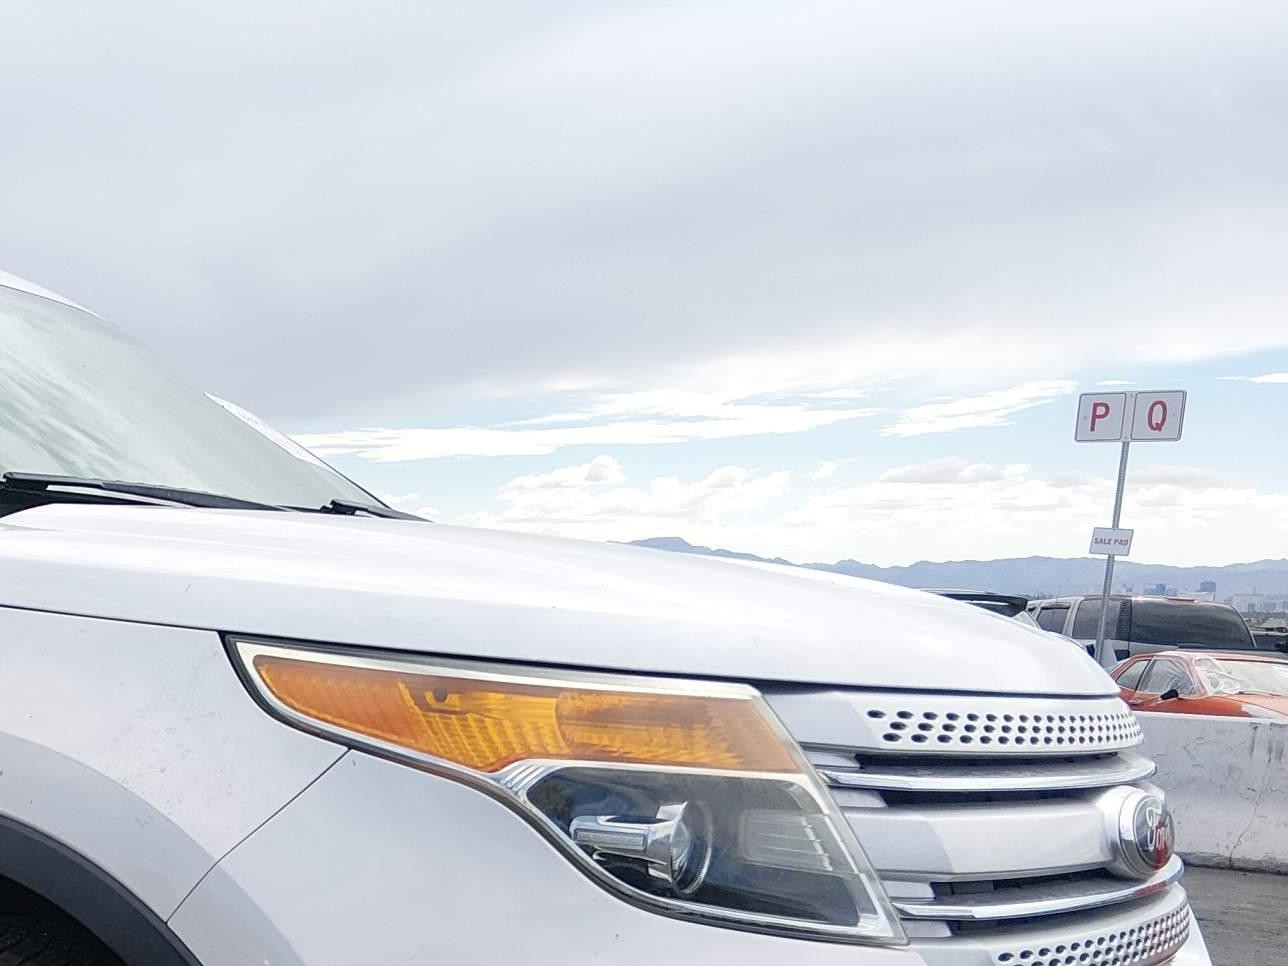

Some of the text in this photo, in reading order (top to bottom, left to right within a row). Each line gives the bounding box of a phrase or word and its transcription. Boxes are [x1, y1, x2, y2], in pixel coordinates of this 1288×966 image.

[1090, 401, 1110, 431] P
[1147, 400, 1167, 431] Q
[1113, 538, 1129, 546] PAD
